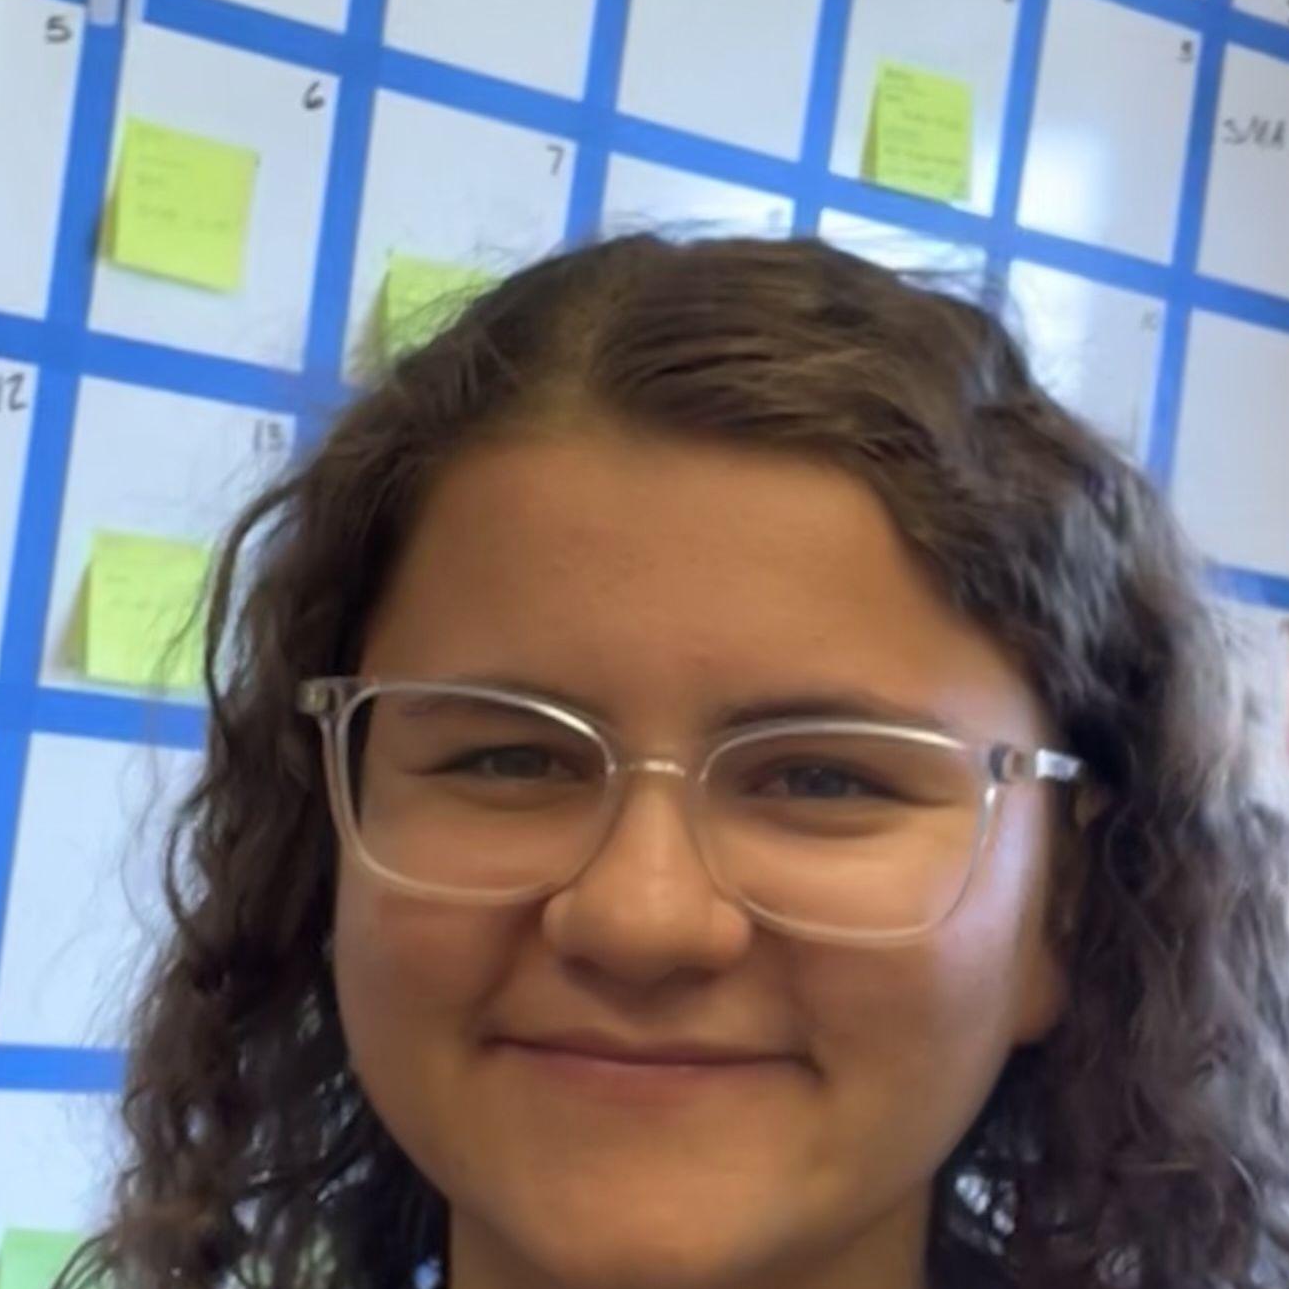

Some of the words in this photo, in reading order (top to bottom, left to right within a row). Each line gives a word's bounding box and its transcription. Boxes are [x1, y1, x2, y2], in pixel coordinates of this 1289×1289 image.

[44, 15, 73, 44] 5
[301, 81, 326, 112] 6
[546, 146, 565, 177] 7
